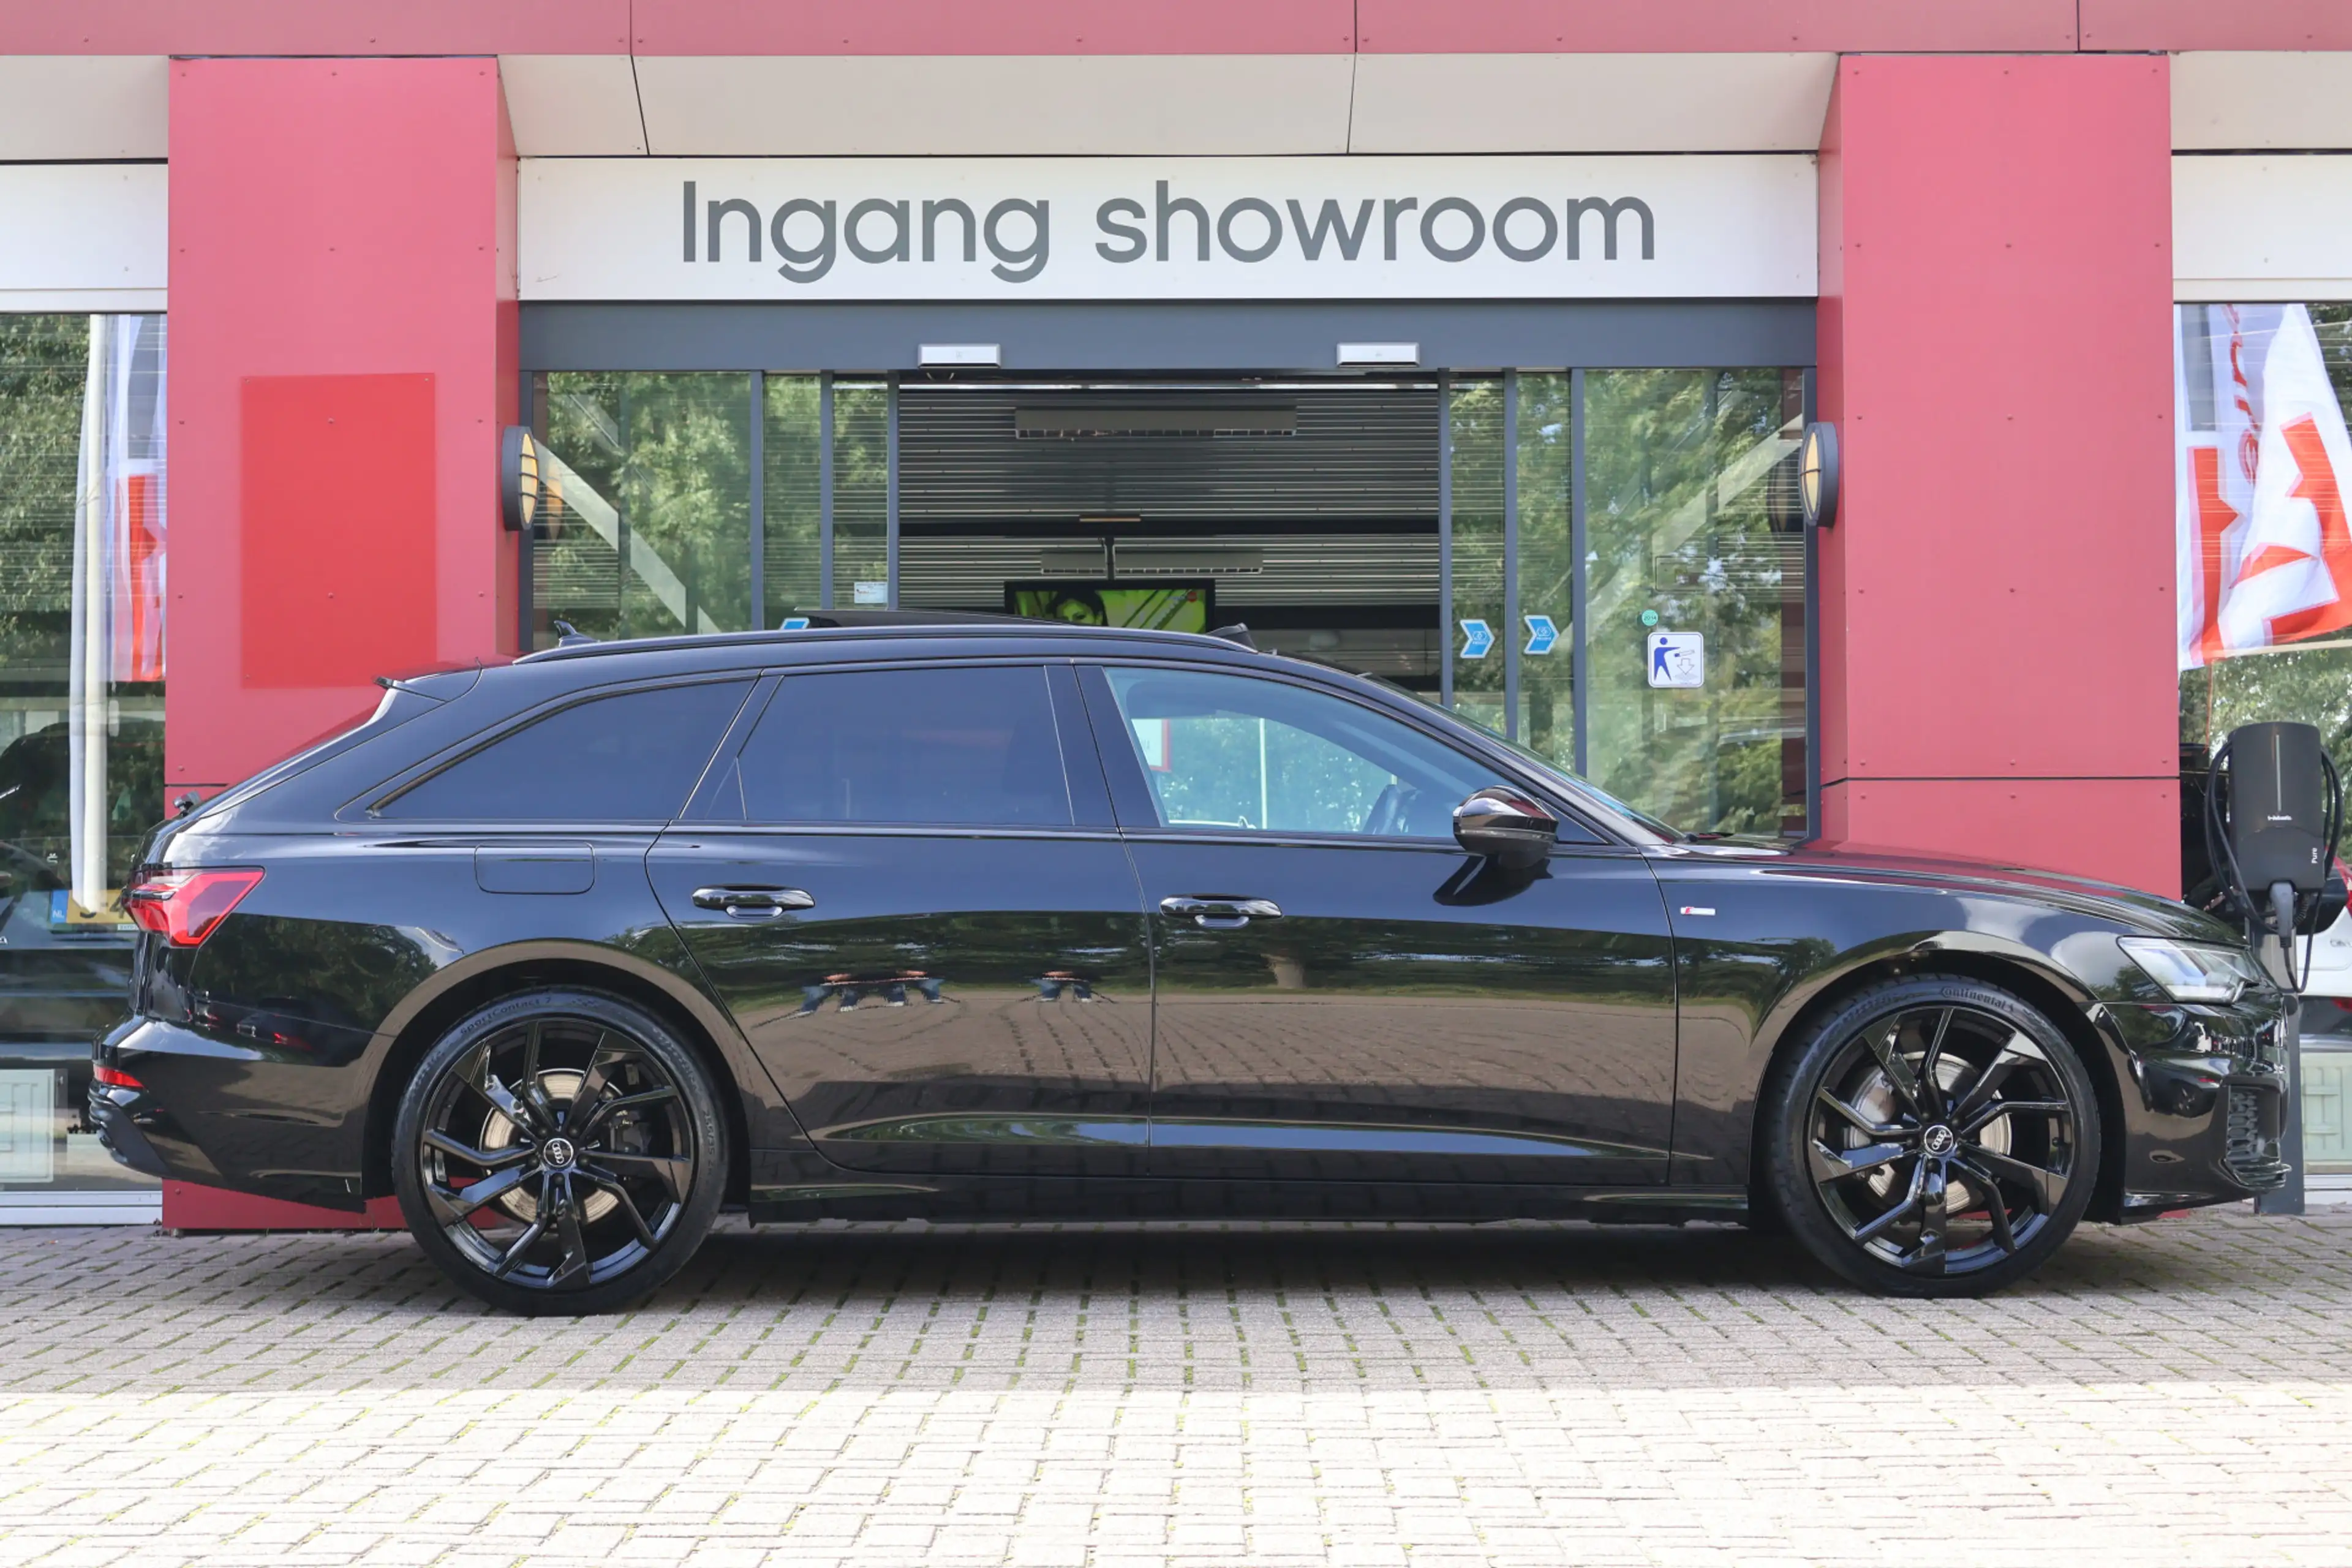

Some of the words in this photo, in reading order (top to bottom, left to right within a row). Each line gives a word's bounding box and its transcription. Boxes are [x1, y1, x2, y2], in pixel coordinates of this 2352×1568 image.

[684, 181, 1050, 284] Ingang
[1095, 180, 1655, 263] showroom
[53, 910, 64, 918] NL
[1940, 986, 2006, 1011] Continental
